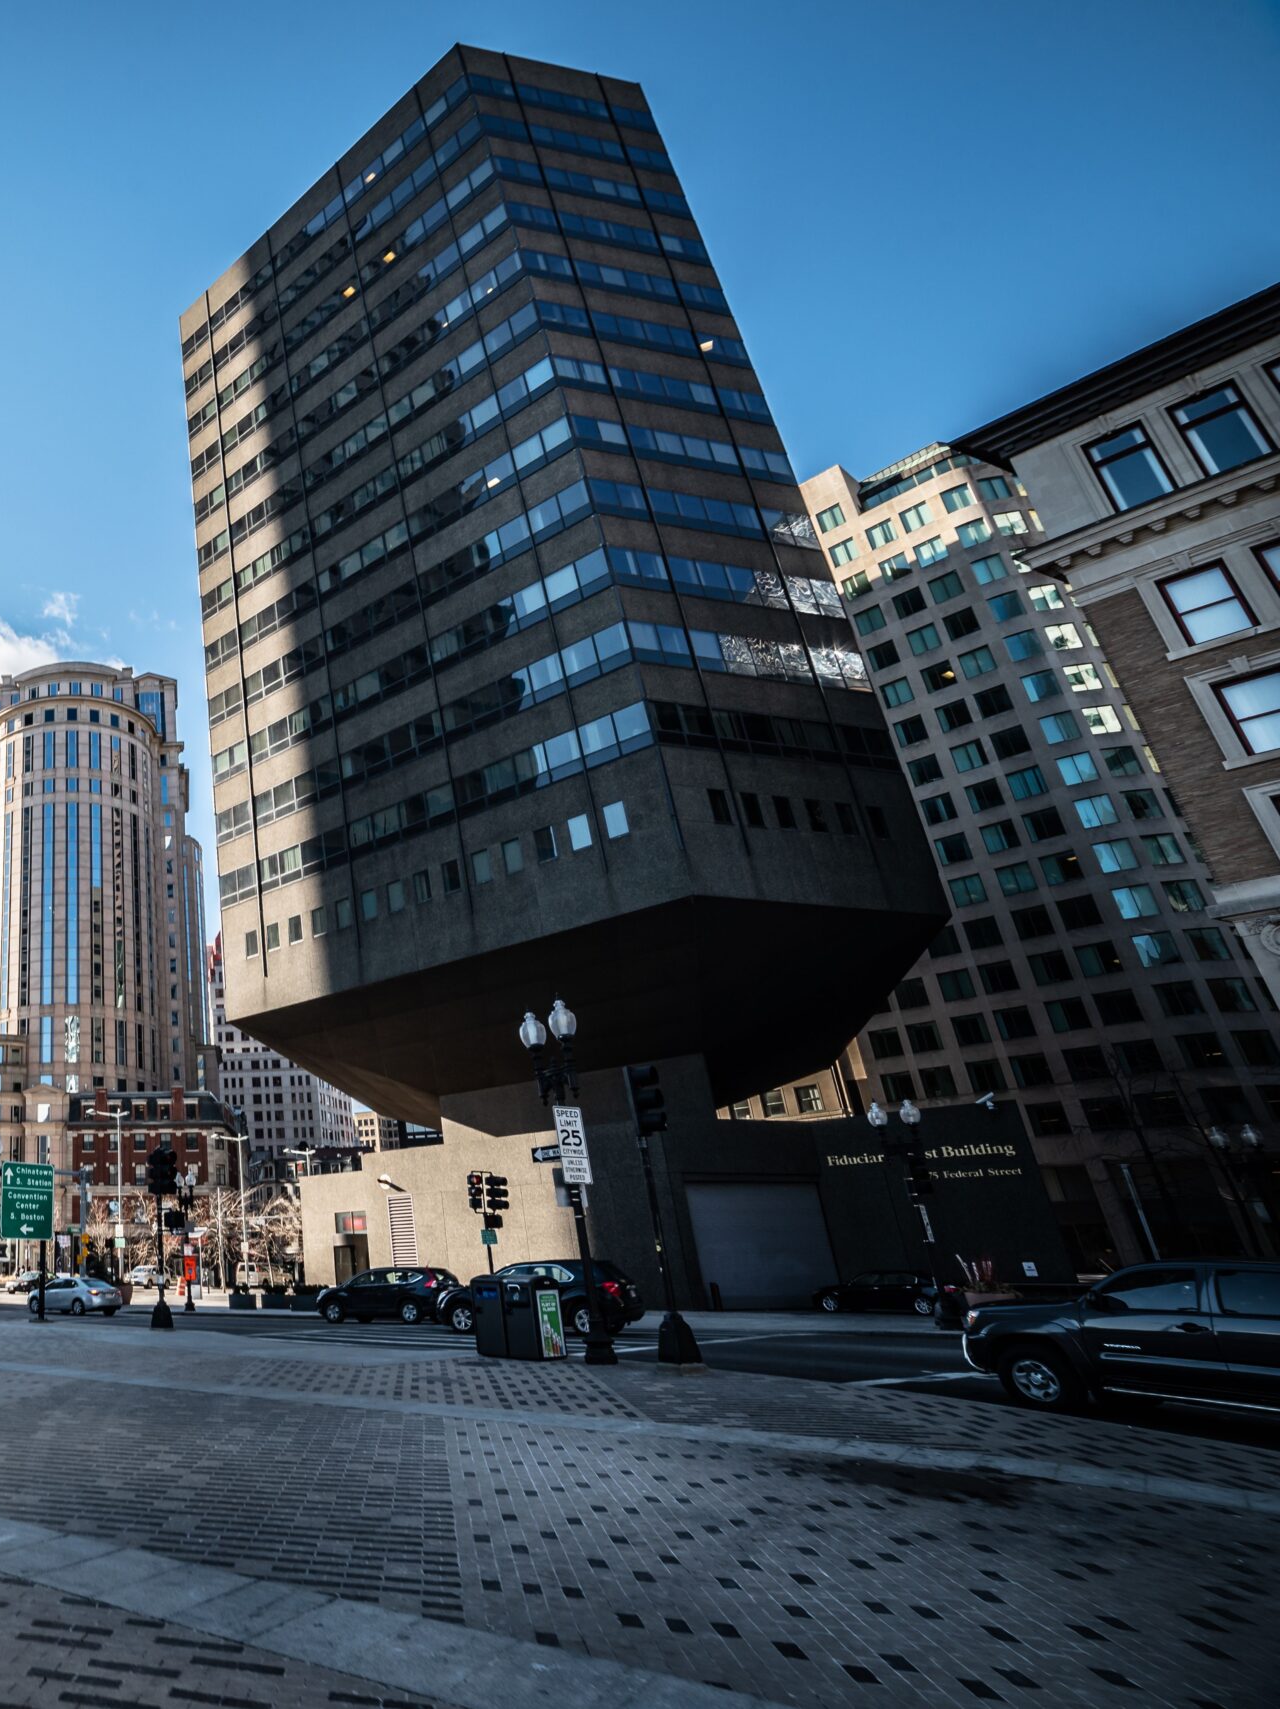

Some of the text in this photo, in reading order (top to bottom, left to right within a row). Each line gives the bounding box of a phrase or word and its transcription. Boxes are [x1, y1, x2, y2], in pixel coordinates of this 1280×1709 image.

[556, 1110, 578, 1118] SPEED
[560, 1129, 582, 1146] 25
[562, 1148, 584, 1156] CITYWIDE
[827, 1153, 884, 1166] Fiduciar
[941, 1143, 1016, 1157] Building
[16, 1166, 53, 1176] Chinatown
[928, 1168, 1023, 1179] 75 Federal Street
[27, 1178, 52, 1187] Station
[8, 1191, 48, 1200] Convention
[15, 1201, 40, 1210] Center
[10, 1212, 45, 1221] S. Boston
